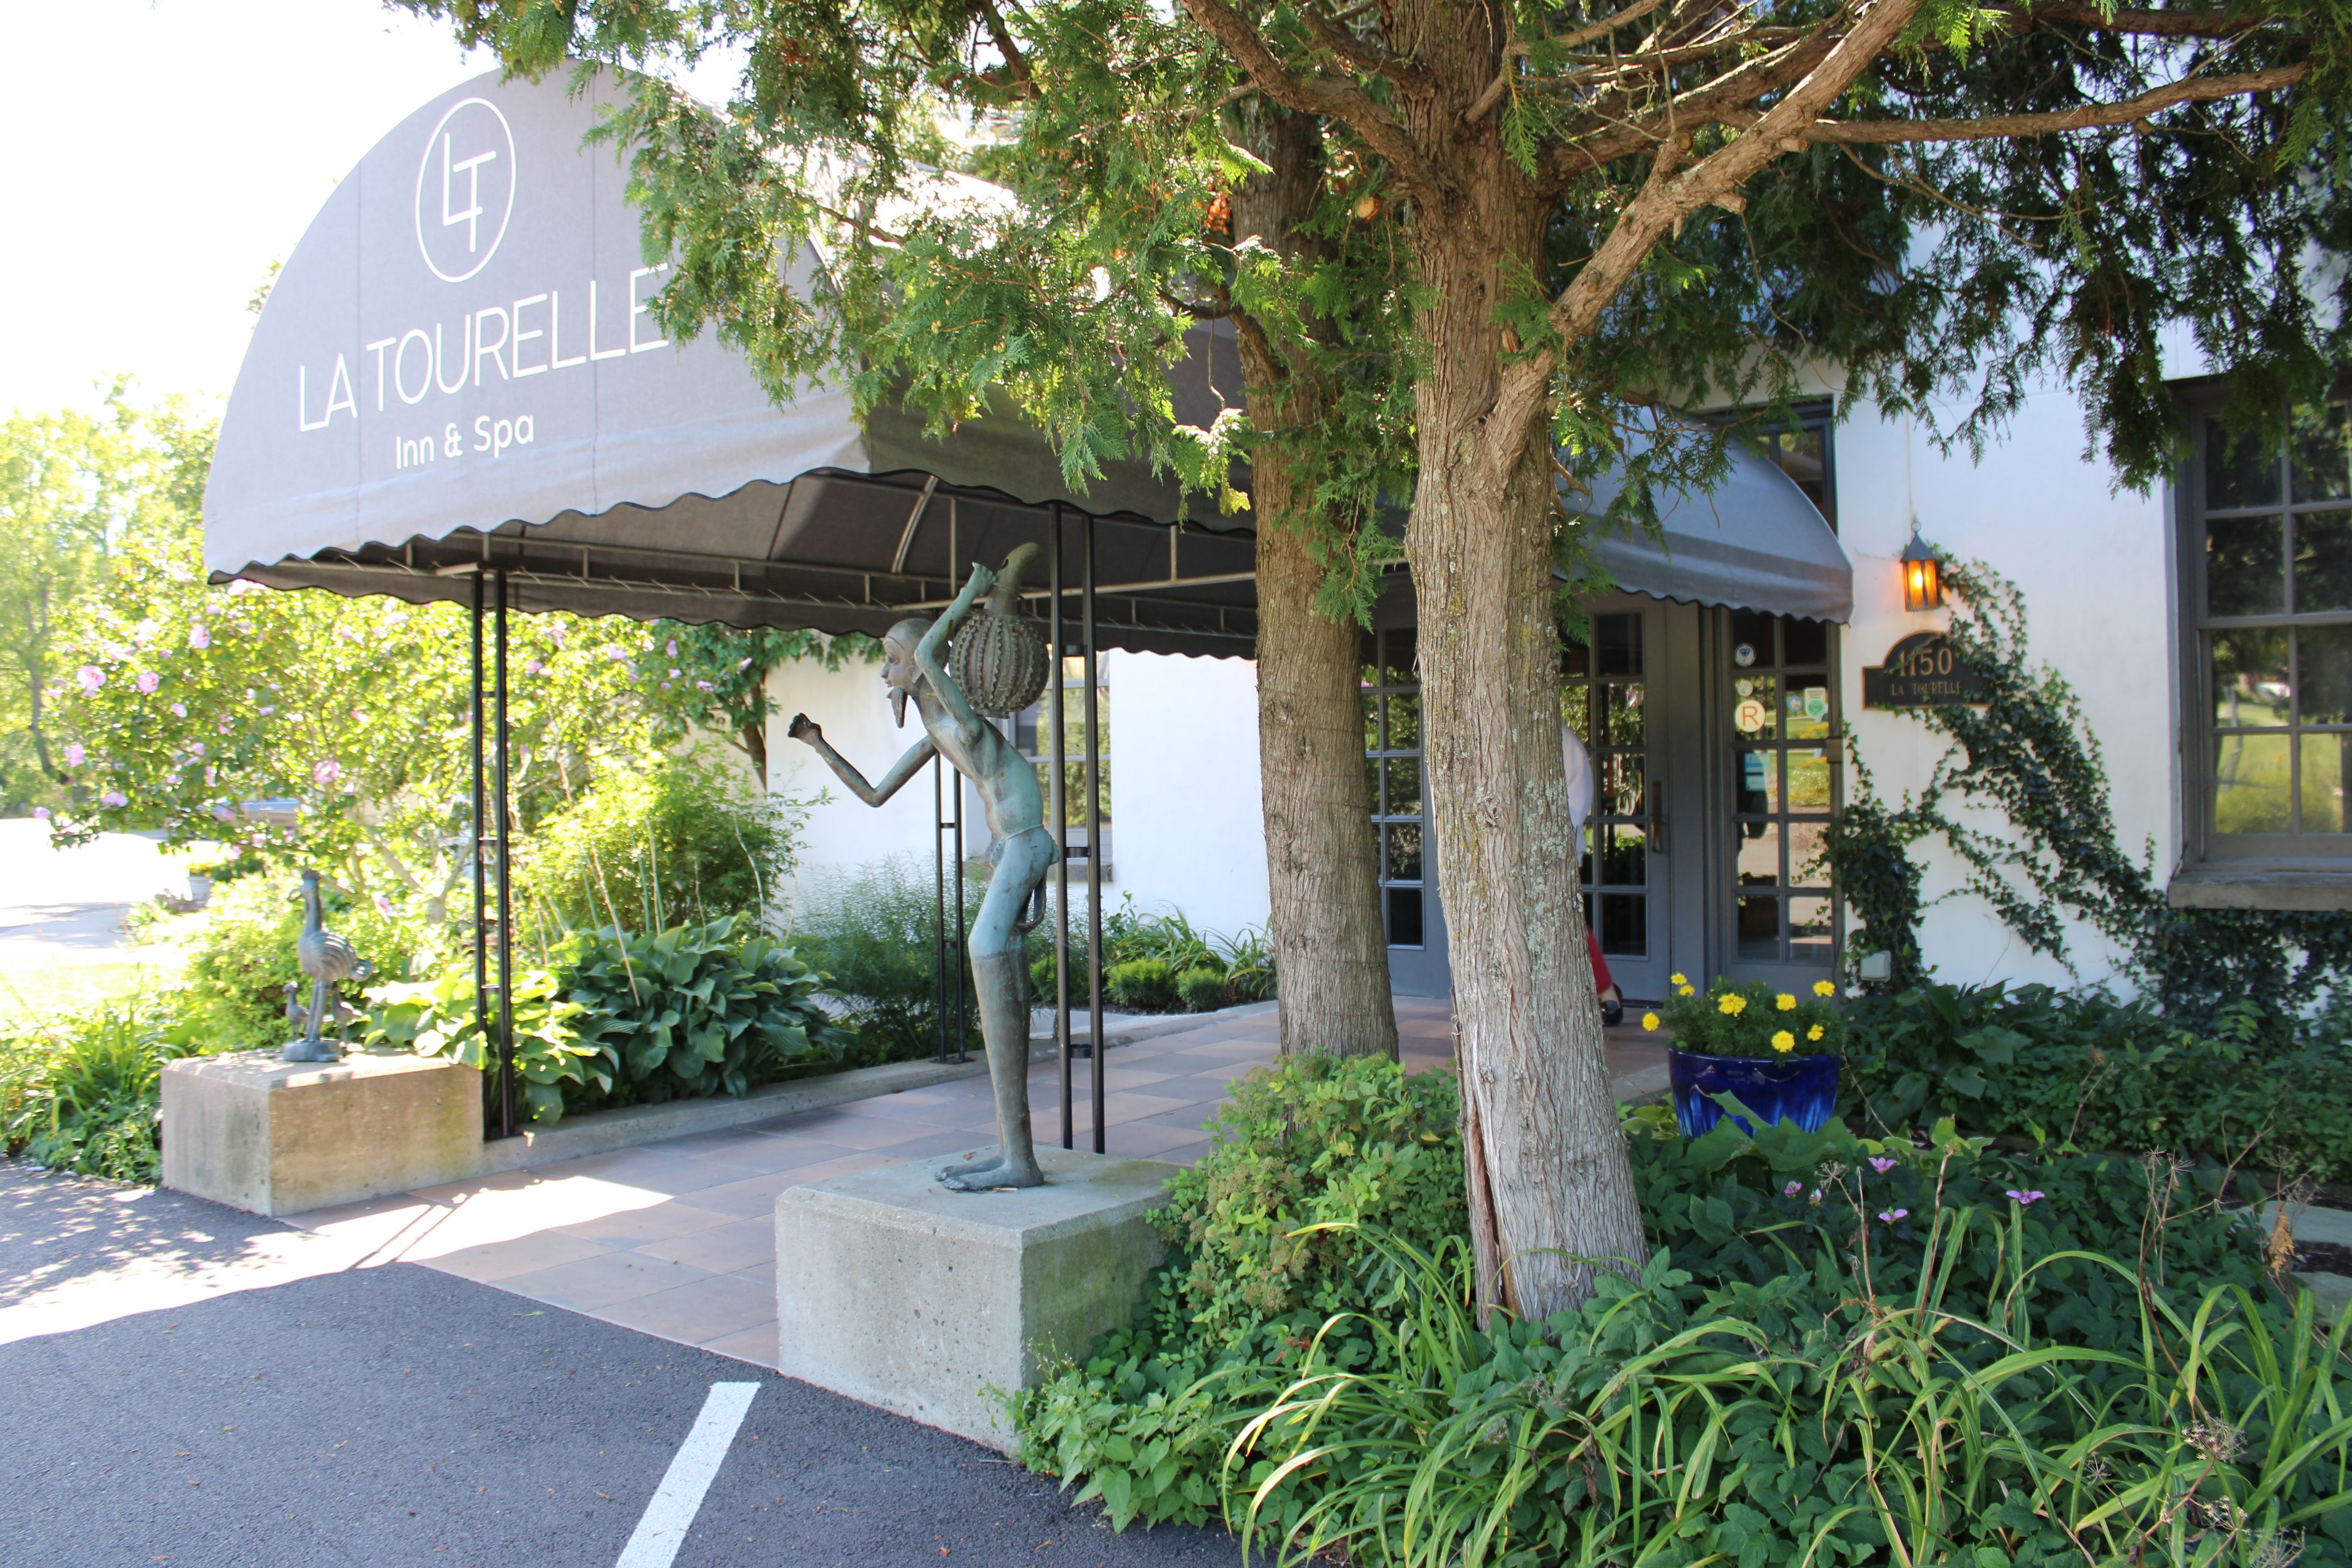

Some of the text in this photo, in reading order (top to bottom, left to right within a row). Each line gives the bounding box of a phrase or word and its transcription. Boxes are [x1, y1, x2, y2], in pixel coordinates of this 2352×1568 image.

[299, 262, 669, 432] LA TOURELLE
[396, 414, 534, 470] Inn & Spa
[1899, 647, 1953, 676] 1150
[1891, 684, 1904, 696] LA
[1741, 706, 1760, 726] R
